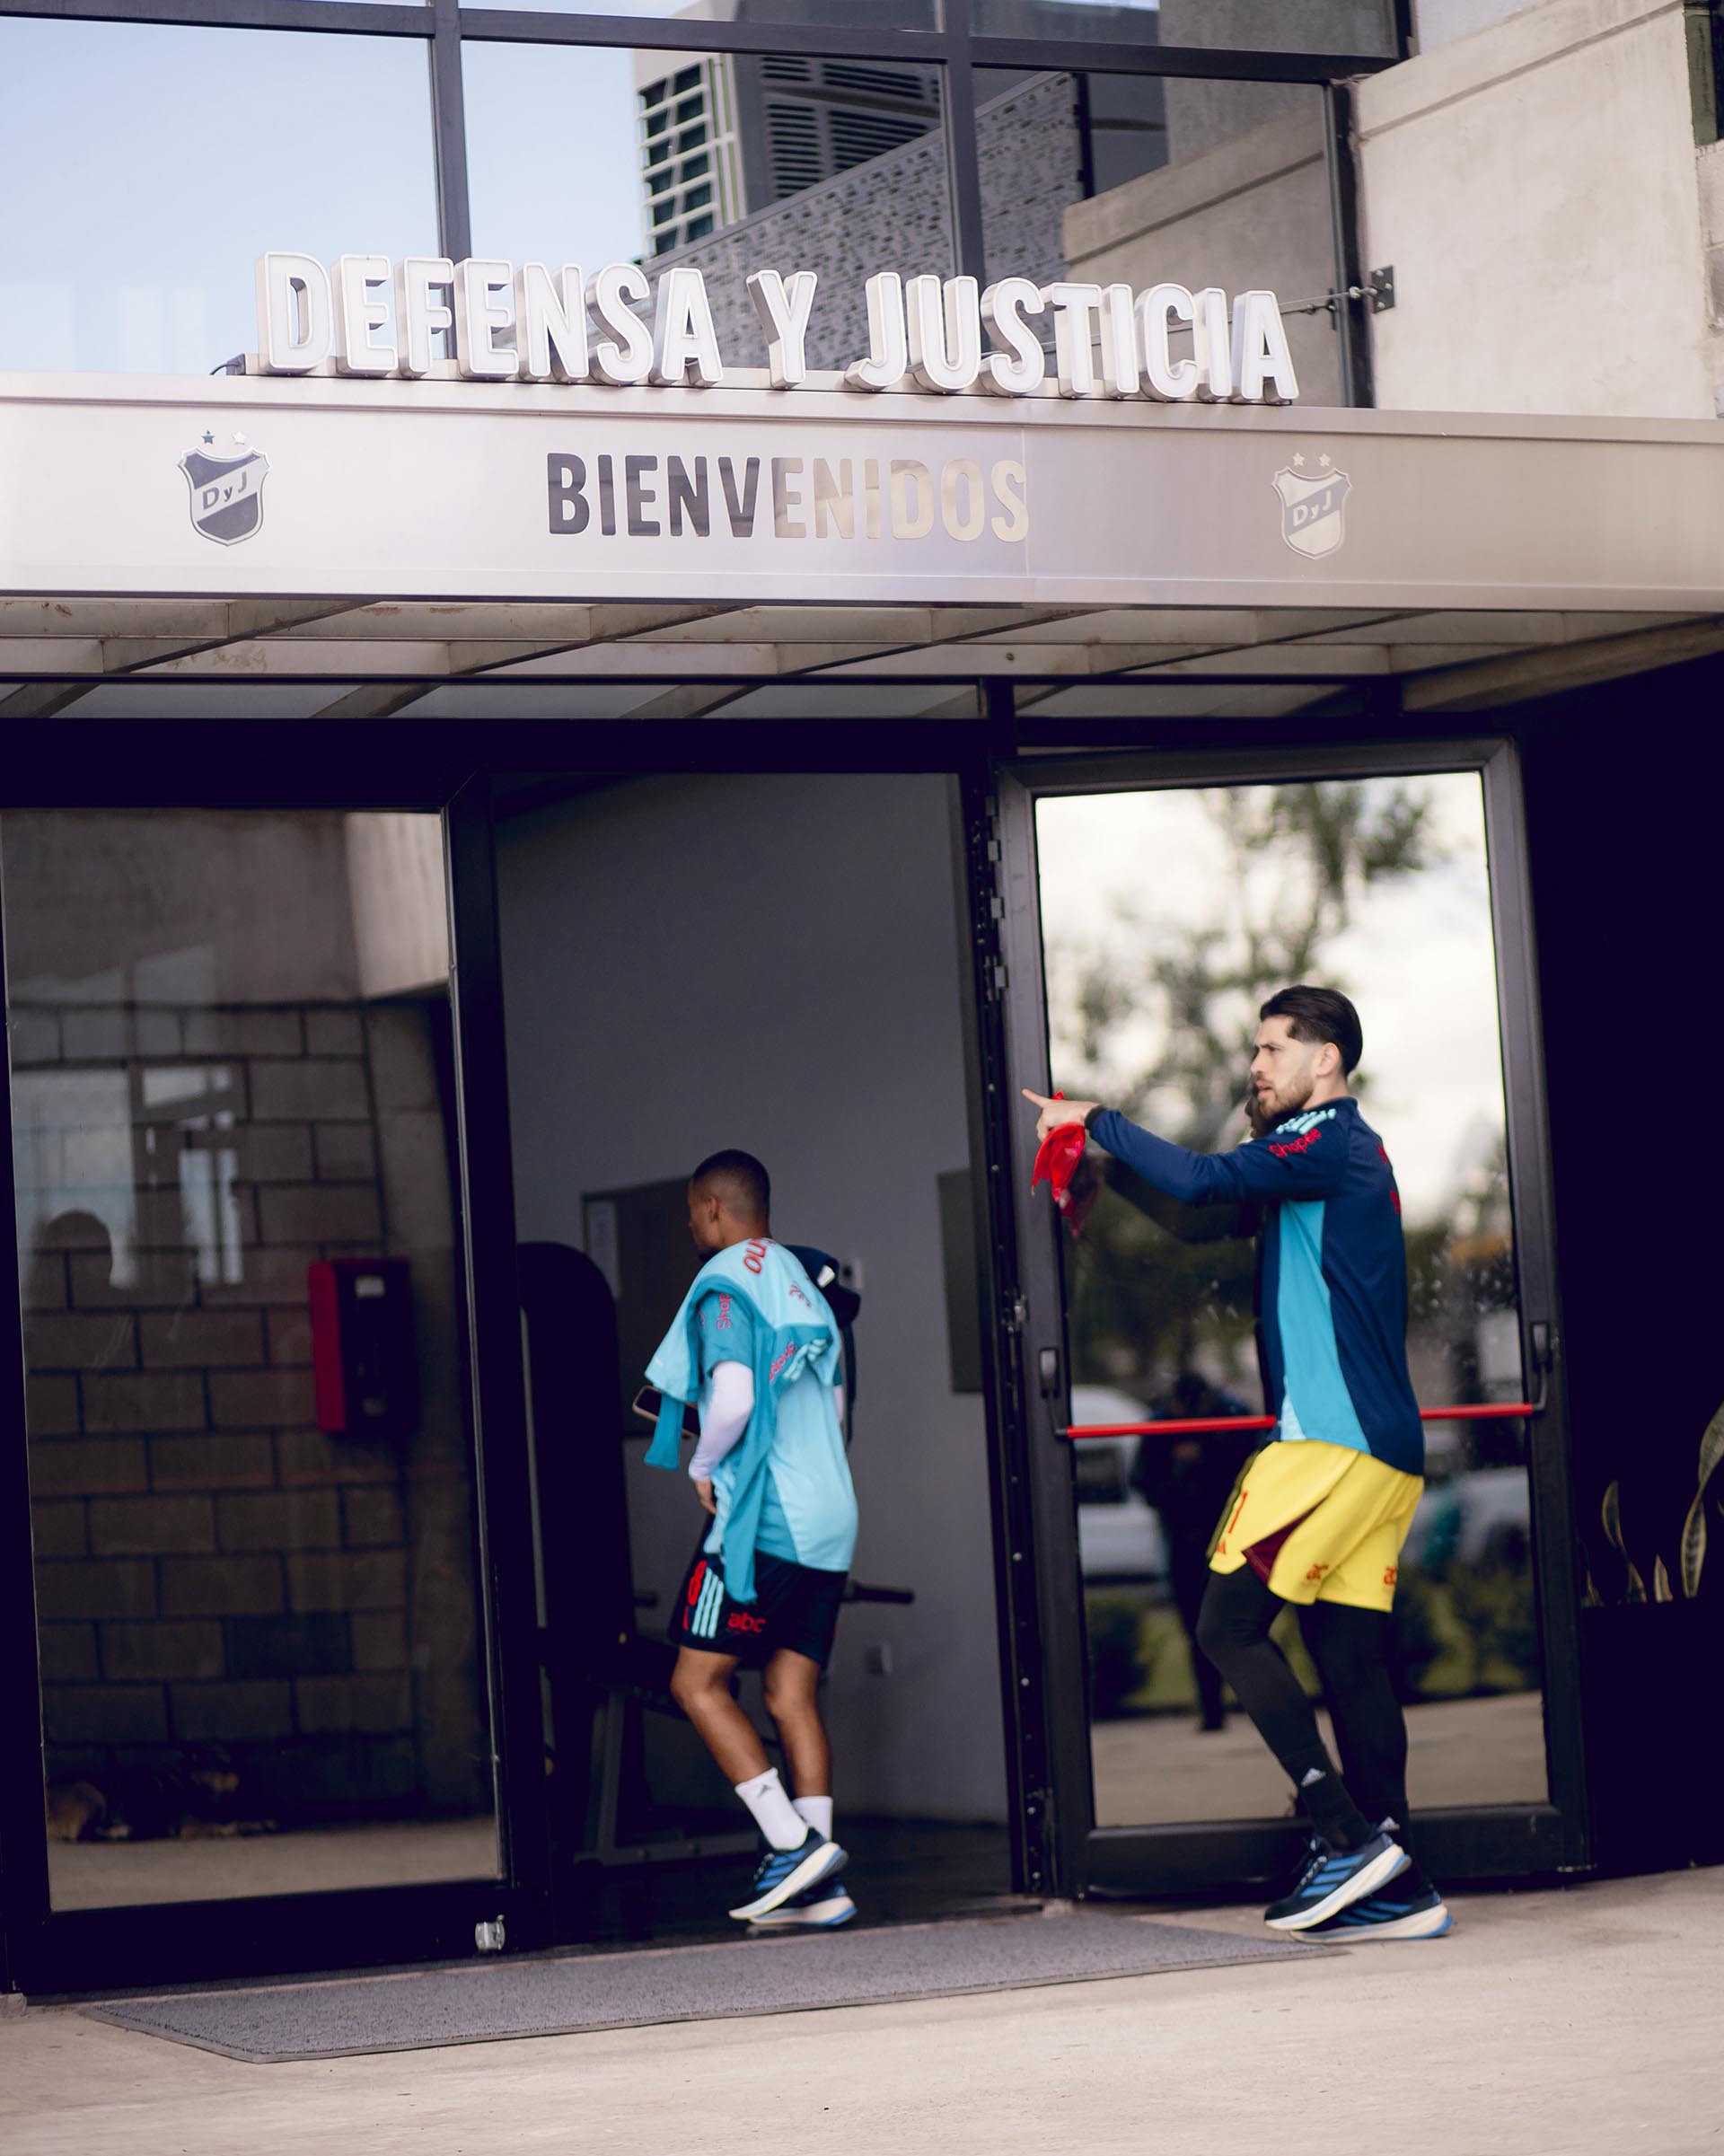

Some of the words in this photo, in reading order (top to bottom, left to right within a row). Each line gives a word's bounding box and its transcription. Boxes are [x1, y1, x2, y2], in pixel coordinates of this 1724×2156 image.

[255, 251, 724, 386] DEFENSA
[746, 268, 818, 389] Y
[846, 271, 1299, 405] JUSTICIA
[547, 452, 1030, 543] BIENVENIDOS
[1269, 1128, 1323, 1158] Shopee
